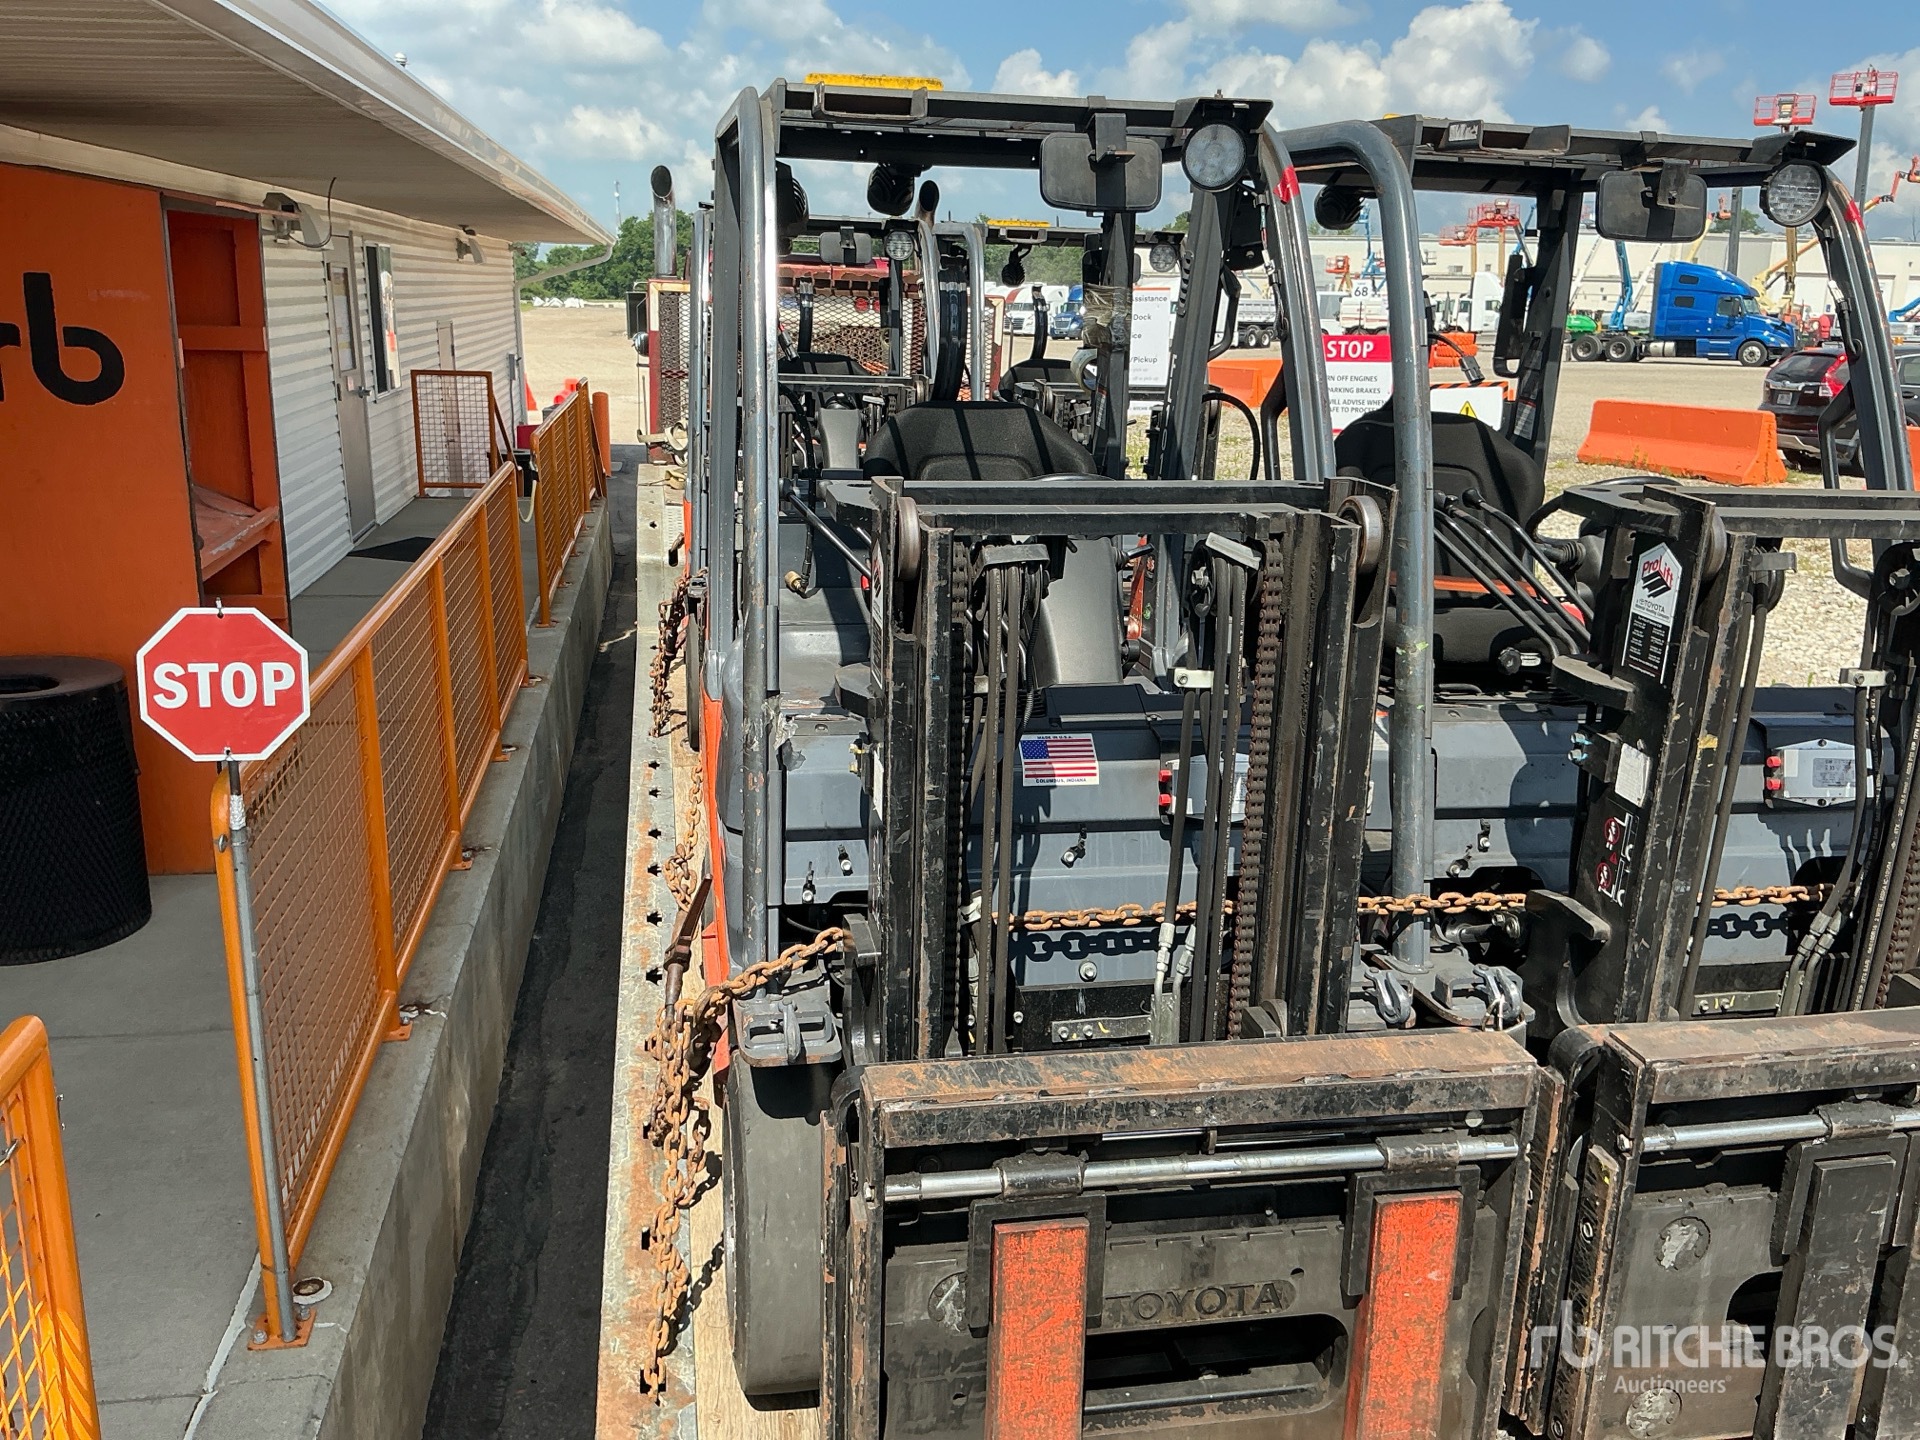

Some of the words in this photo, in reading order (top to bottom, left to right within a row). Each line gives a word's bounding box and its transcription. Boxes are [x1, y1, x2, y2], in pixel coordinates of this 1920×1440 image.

[1354, 286, 1368, 296] 68
[0, 272, 124, 405] b
[1326, 340, 1374, 358] STOP
[1644, 600, 1665, 613] TOYOTA
[153, 662, 296, 708] STOP
[1104, 1281, 1283, 1322] TOYOTA
